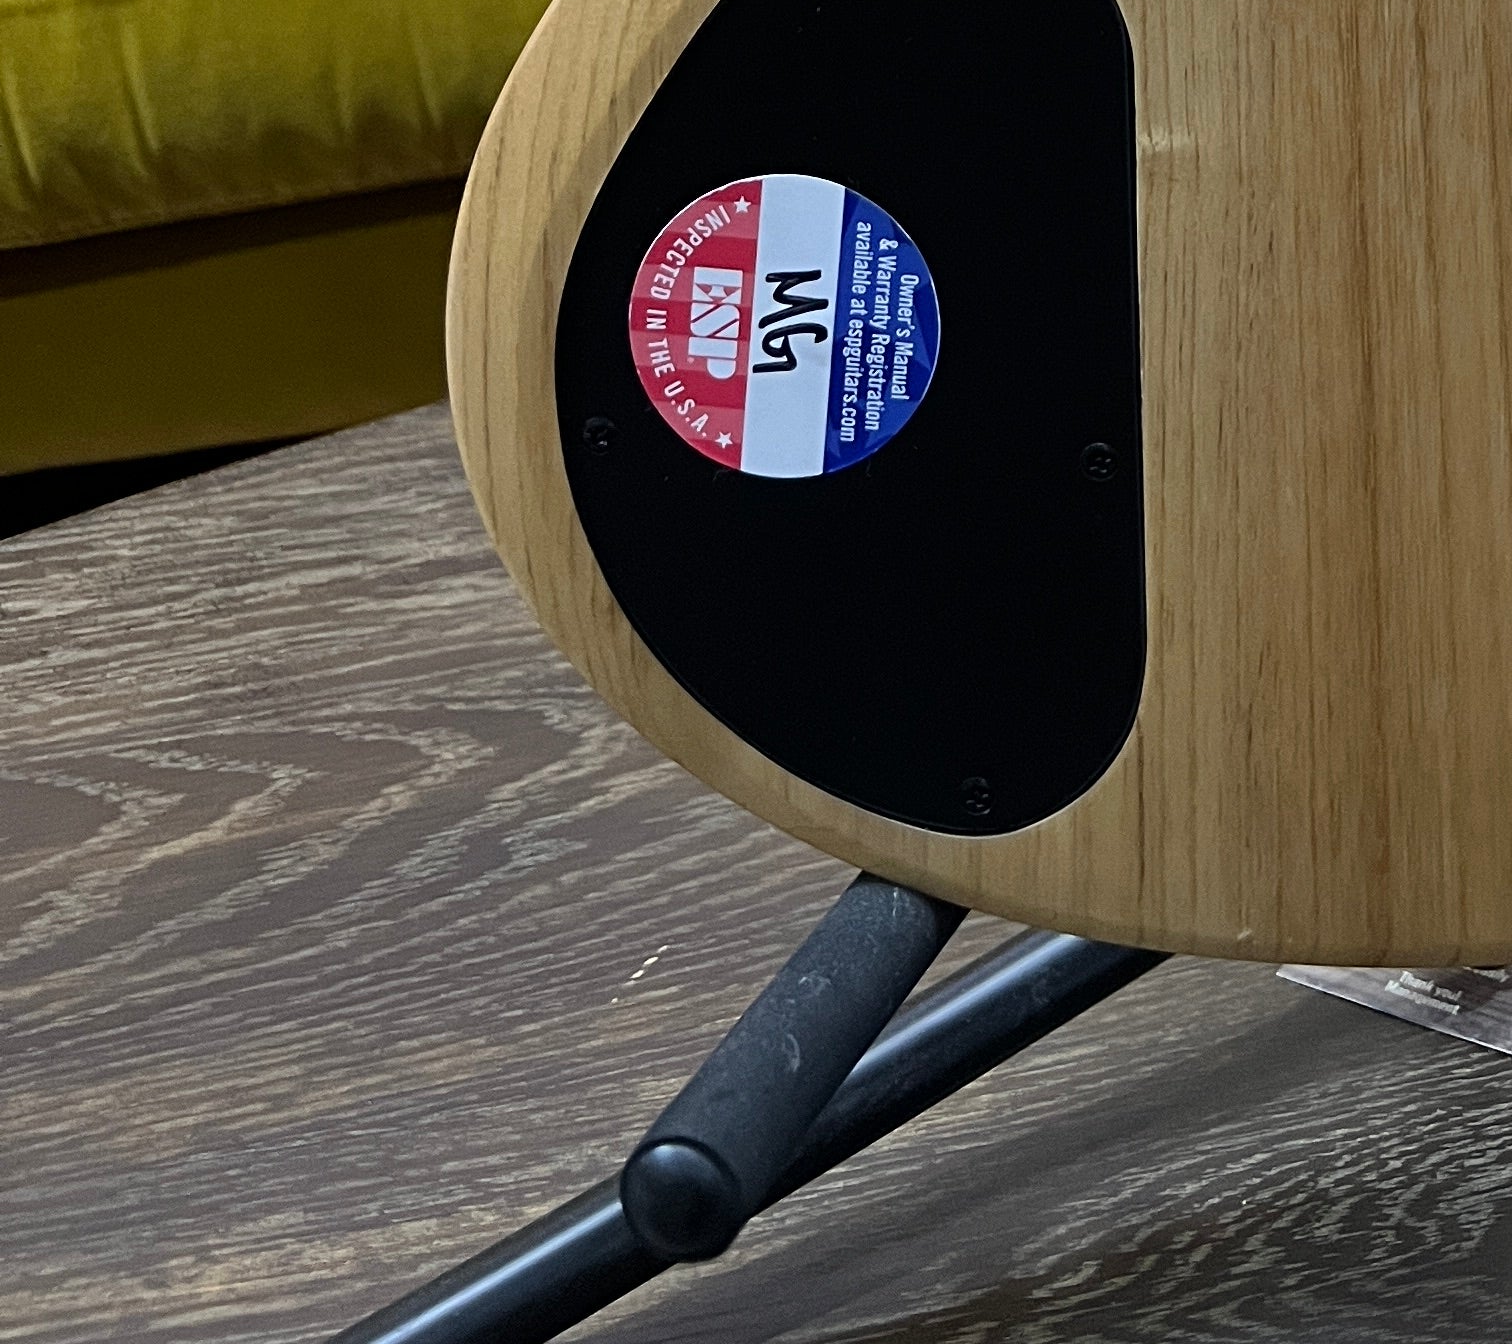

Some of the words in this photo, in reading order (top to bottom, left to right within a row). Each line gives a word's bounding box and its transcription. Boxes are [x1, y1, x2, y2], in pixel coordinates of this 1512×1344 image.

[650, 205, 731, 300] INSPECTED
[851, 221, 874, 294] available
[879, 238, 899, 251] &
[646, 308, 667, 330] IN
[688, 266, 743, 380] ESP
[849, 298, 868, 316] at
[869, 255, 897, 330] Warranty
[896, 274, 919, 338] Owner's
[648, 337, 676, 378] THE
[840, 319, 864, 442] espguitars.com
[864, 333, 891, 431] Registration
[891, 341, 914, 400] Manual
[664, 380, 709, 437] U.S.A.
